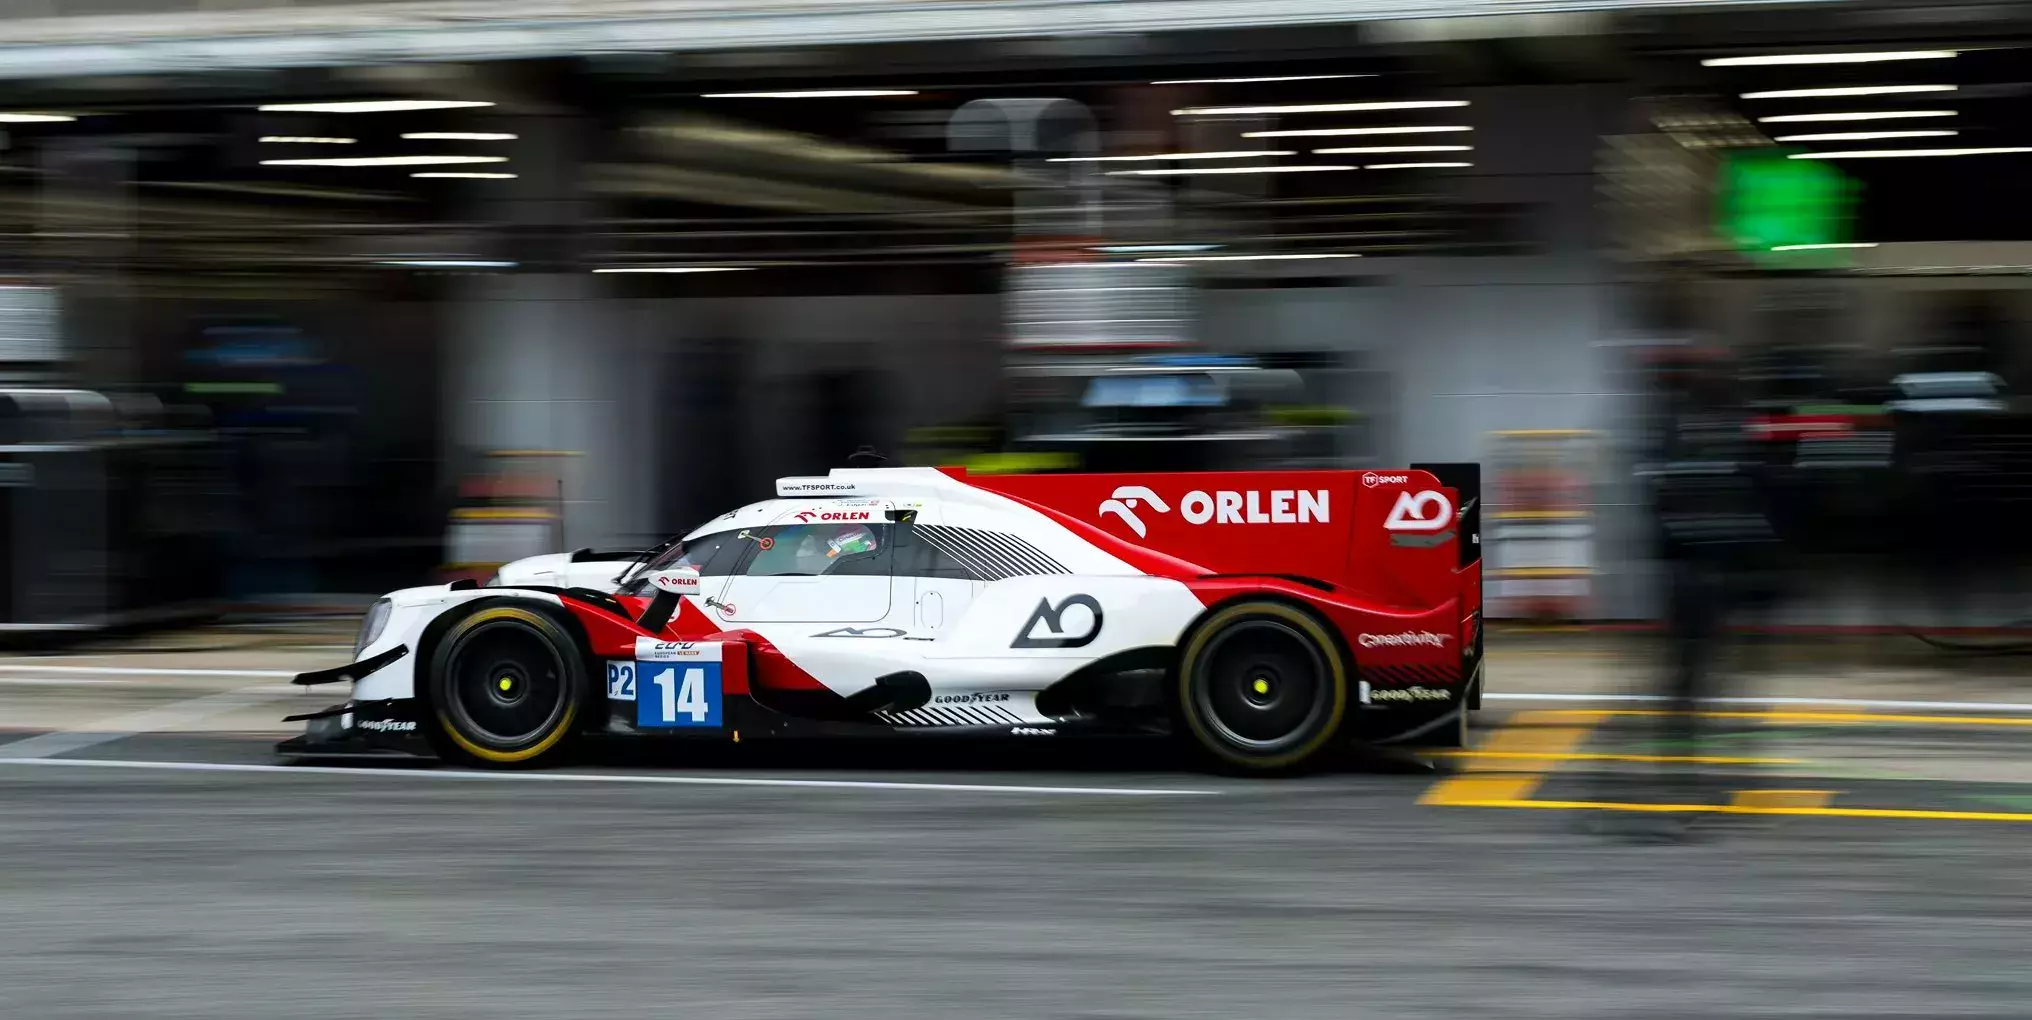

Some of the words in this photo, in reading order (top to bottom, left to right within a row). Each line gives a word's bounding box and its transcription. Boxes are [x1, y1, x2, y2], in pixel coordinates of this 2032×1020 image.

[1379, 476, 1408, 484] SPORT
[1180, 489, 1330, 525] ORLEN
[821, 512, 870, 521] ORLEN
[671, 578, 697, 586] ORLEN
[608, 664, 634, 695] P2
[653, 668, 709, 722] 14
[934, 692, 1010, 704] GOODYEAR
